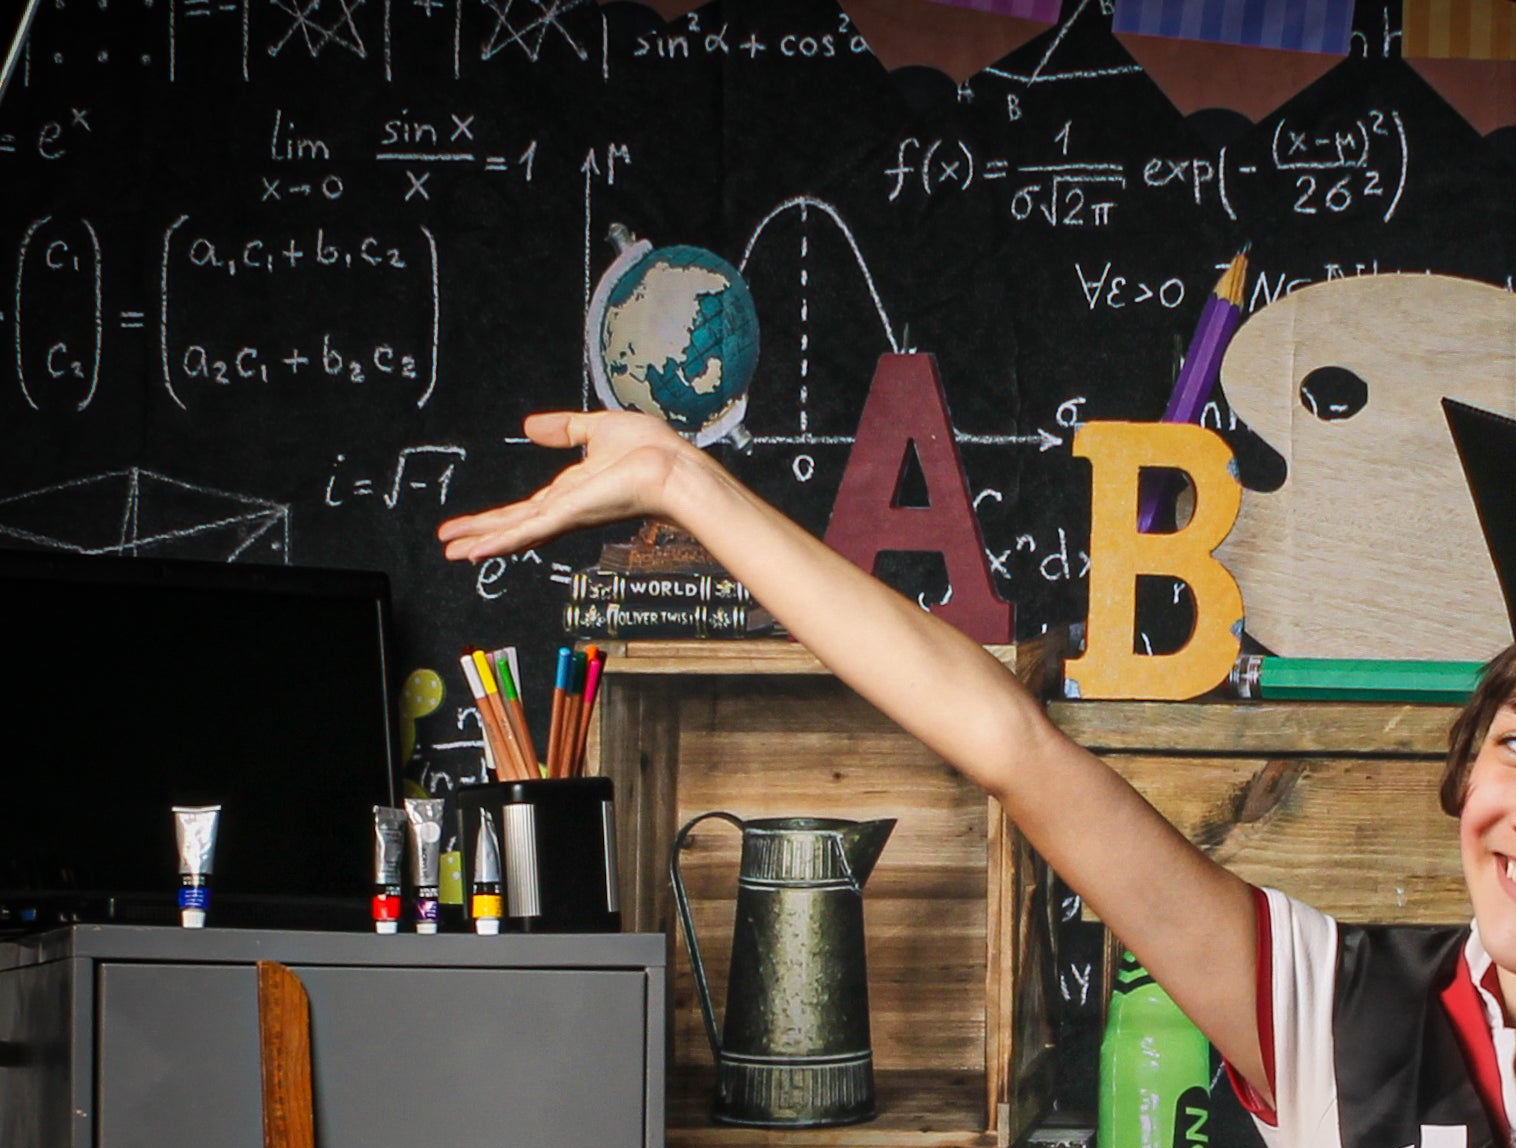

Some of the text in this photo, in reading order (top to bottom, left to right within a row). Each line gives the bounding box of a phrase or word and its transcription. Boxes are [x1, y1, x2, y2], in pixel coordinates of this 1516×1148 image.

[1072, 421, 1243, 701] B
[629, 580, 698, 597] WORLD
[618, 611, 657, 626] OLIVER
